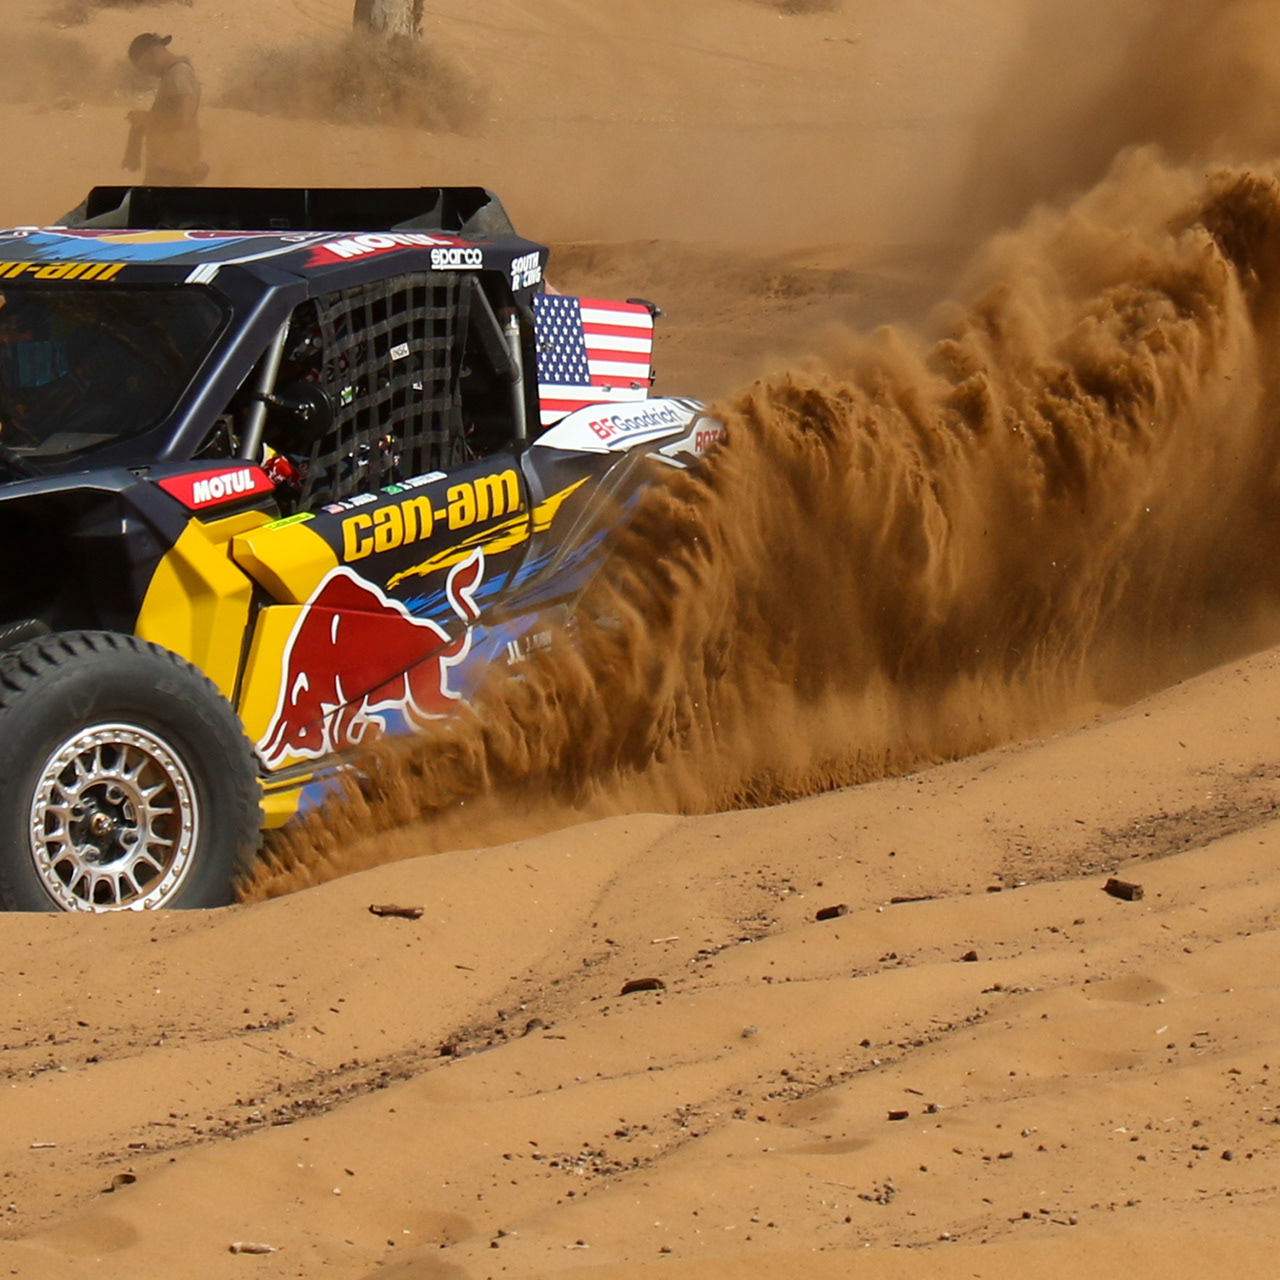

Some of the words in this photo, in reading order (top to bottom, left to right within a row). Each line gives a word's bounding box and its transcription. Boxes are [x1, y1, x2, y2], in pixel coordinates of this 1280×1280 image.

[323, 233, 454, 259] MOTUL
[430, 248, 483, 270] sparco
[510, 251, 540, 277] SOUTH
[588, 405, 684, 440] BFGoodrich
[193, 469, 256, 504] MOTUL
[342, 469, 521, 563] can-am
